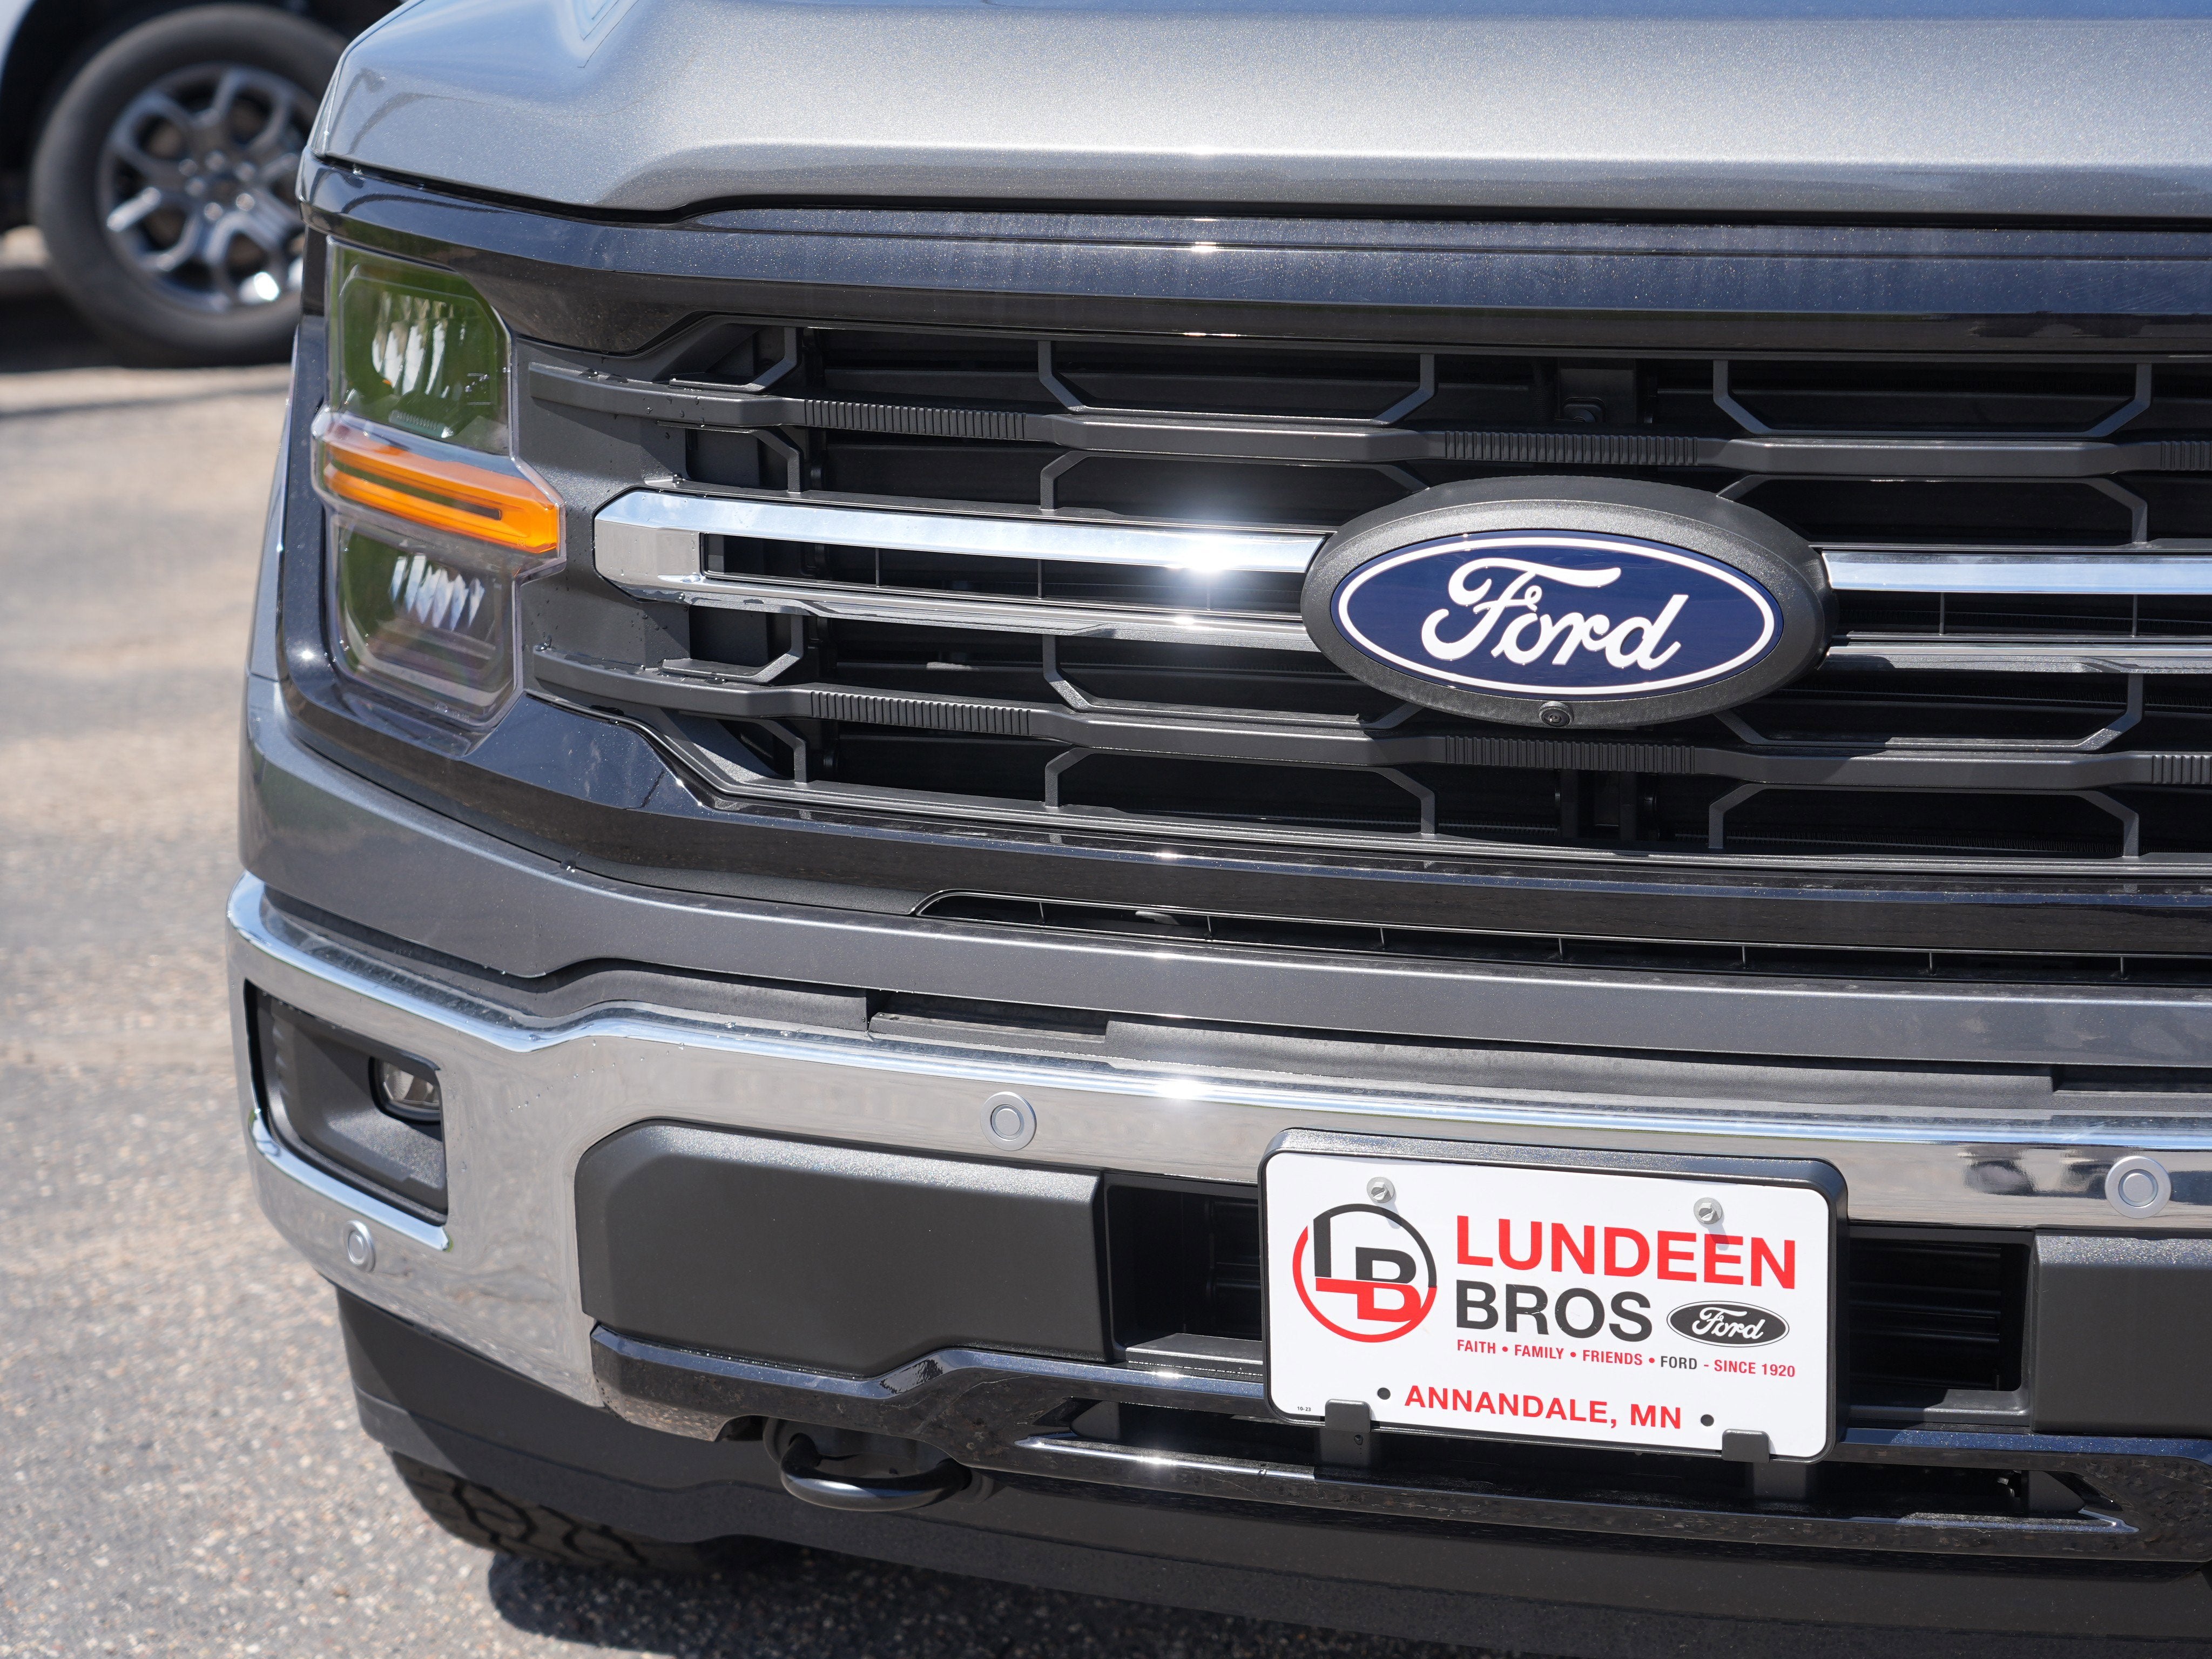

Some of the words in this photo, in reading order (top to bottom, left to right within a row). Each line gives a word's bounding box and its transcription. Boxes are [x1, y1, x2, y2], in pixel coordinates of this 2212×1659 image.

[1421, 558, 1689, 670] Ford
[1457, 1215, 1796, 1290] LUNDEEN
[1456, 1279, 1653, 1342] BROS
[1692, 1306, 1765, 1340] Ford
[1457, 1339, 1496, 1354] FAITH
[1514, 1344, 1564, 1359] FAMILY
[1583, 1350, 1643, 1366] FRIENDS
[1661, 1355, 1698, 1370] FORD
[1714, 1359, 1756, 1376] SINCE
[1762, 1364, 1796, 1378] 1920
[1405, 1385, 1617, 1428] ANNANDALE,
[1630, 1404, 1681, 1430] MN
